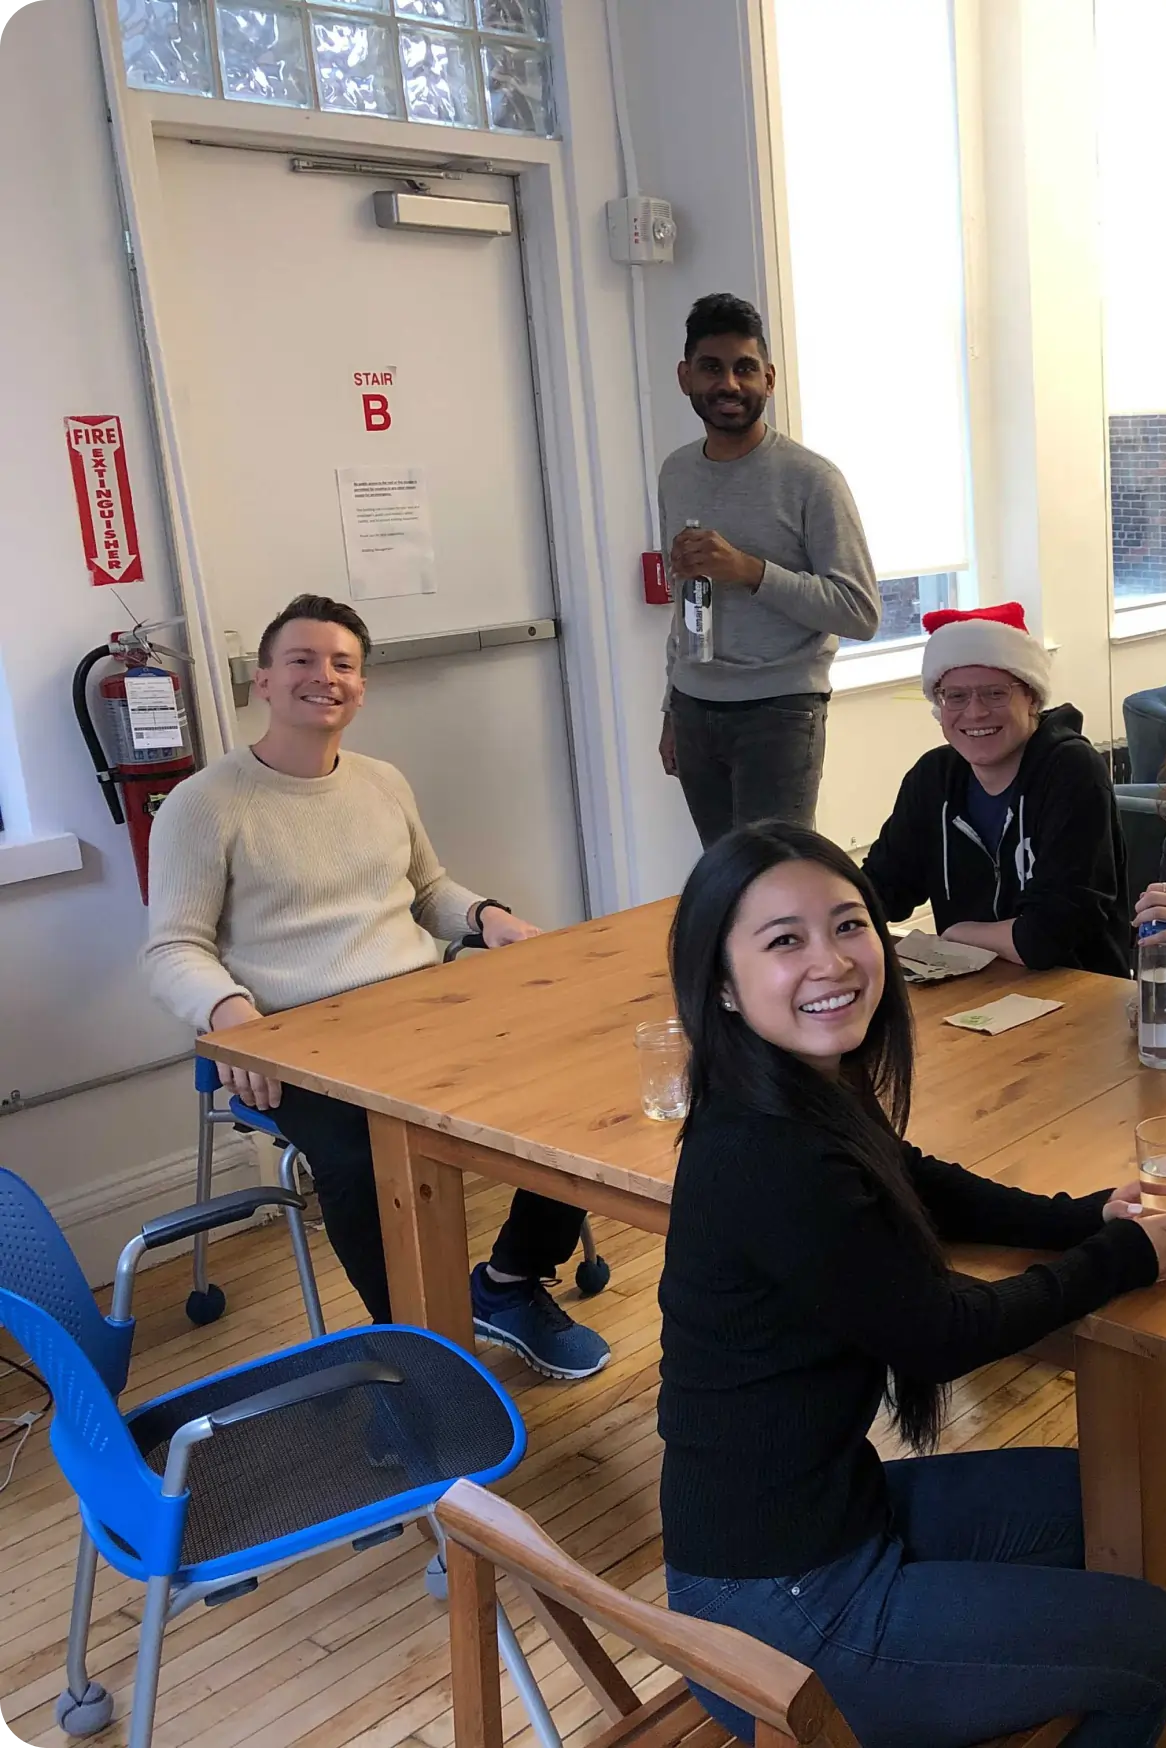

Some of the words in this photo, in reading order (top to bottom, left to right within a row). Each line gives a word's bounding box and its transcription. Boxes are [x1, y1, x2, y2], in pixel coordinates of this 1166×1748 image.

[353, 372, 393, 386] STAIR
[362, 394, 391, 431] B
[73, 428, 117, 445] FIRE
[91, 448, 122, 570] EXTINGUISHER
